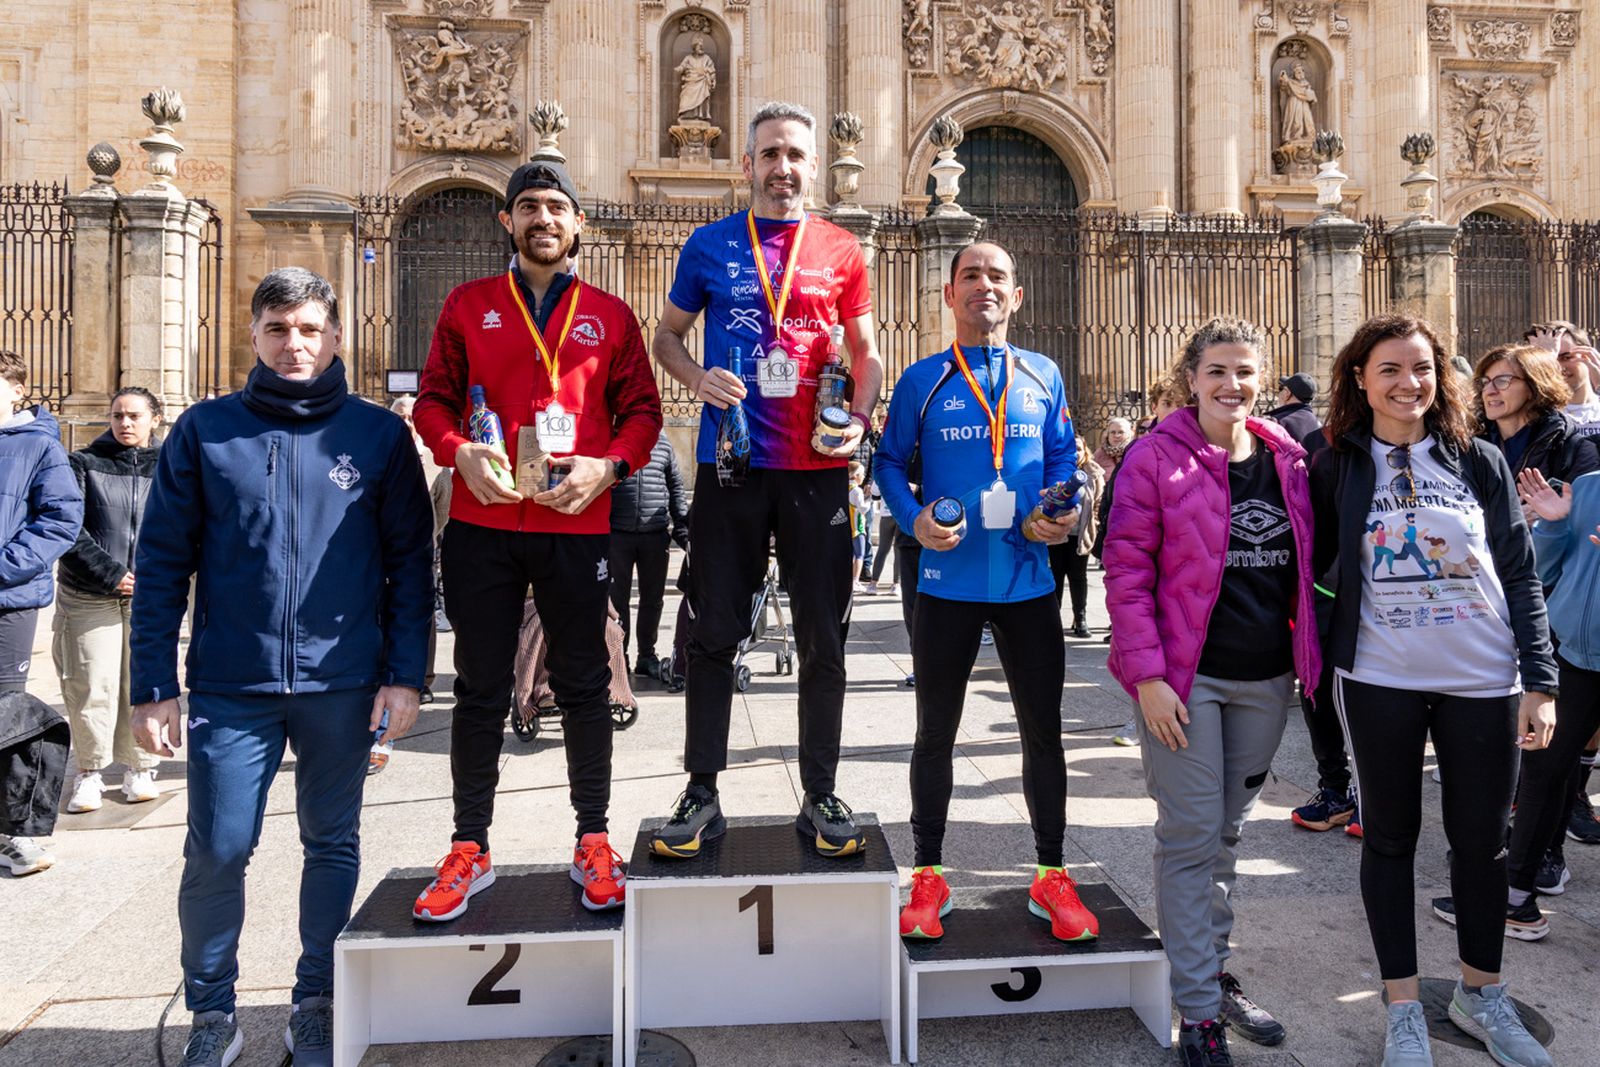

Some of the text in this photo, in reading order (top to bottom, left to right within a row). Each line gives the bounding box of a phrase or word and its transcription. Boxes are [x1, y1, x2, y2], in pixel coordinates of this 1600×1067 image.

[800, 286, 831, 298] wiber
[570, 331, 599, 346] Martos
[940, 424, 1041, 441] TROTAIERRA
[1395, 494, 1450, 510] MUERTE
[738, 885, 774, 956] 1
[467, 943, 521, 1006] 2
